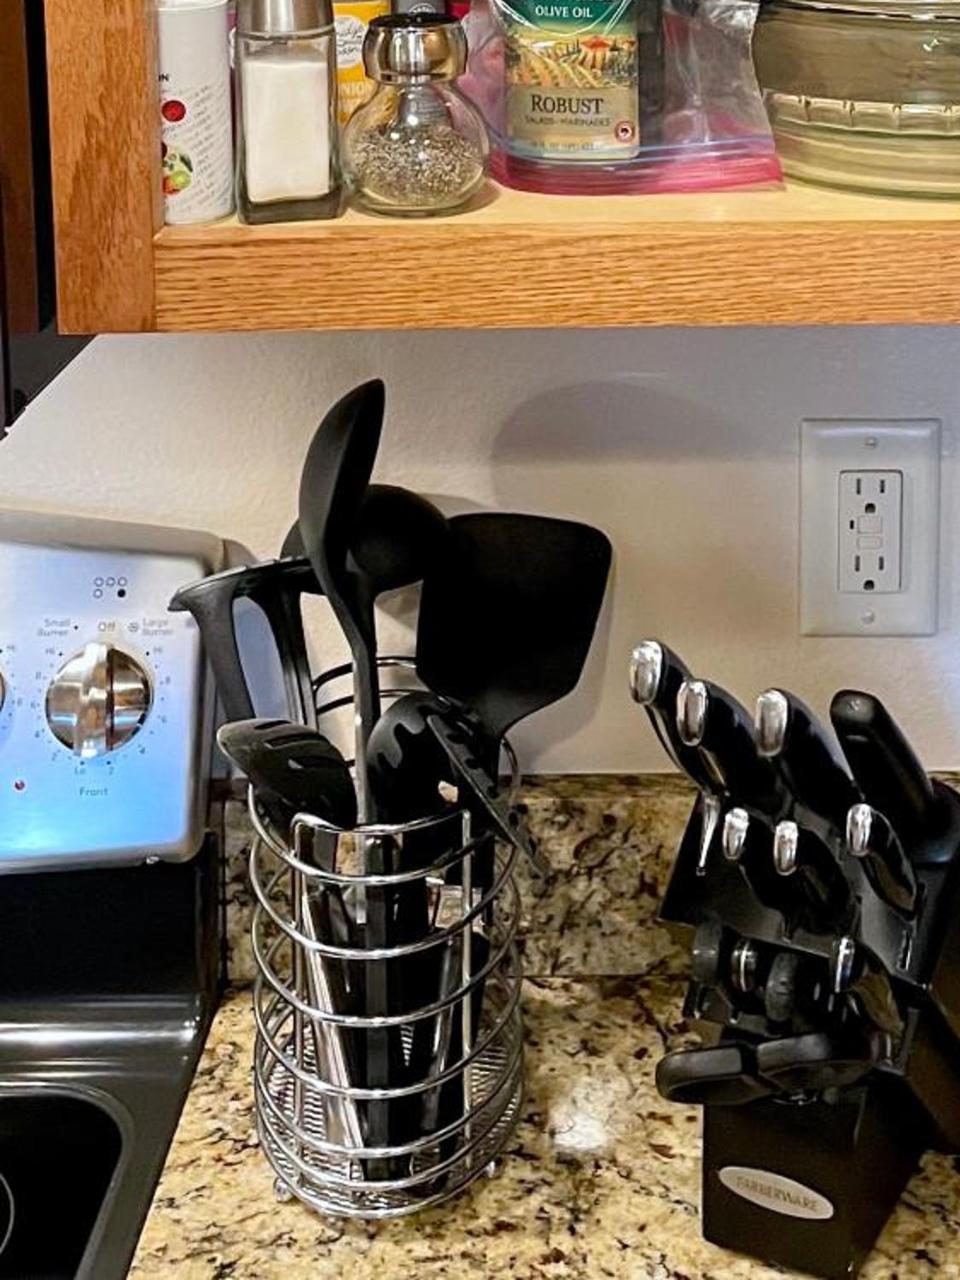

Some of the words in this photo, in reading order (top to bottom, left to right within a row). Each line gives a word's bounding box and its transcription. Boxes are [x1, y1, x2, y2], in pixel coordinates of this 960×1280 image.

[535, 5, 569, 17] OLIVE
[572, 7, 593, 18] OIL
[530, 94, 604, 115] ROBUST
[97, 621, 116, 632] Off
[79, 786, 108, 796] Front
